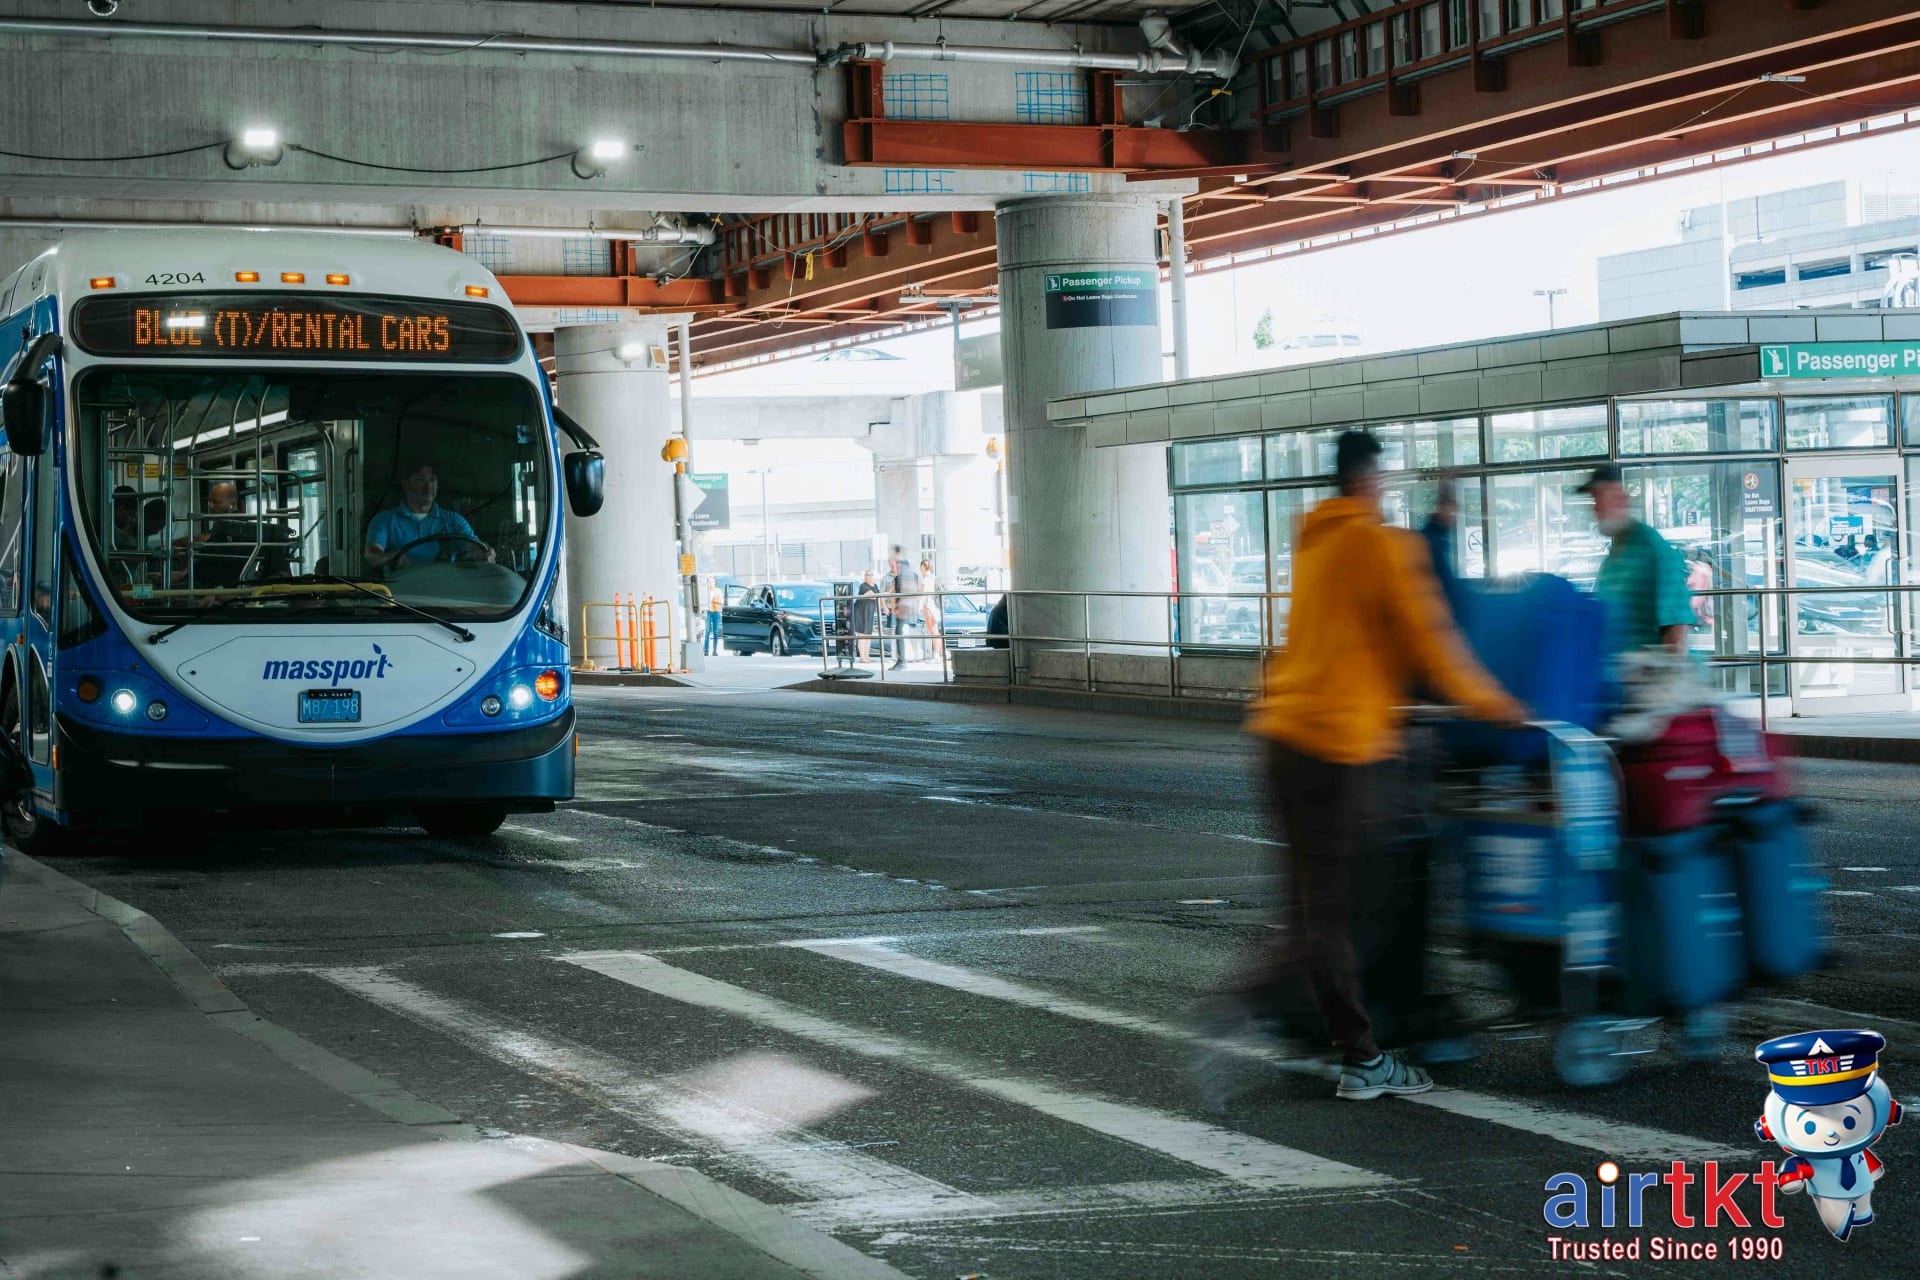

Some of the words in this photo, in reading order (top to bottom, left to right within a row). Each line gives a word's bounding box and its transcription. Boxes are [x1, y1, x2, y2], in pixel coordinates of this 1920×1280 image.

[145, 271, 206, 285] 4204
[1062, 277, 1112, 287] Passenger
[1114, 275, 1141, 286] Pickup
[135, 309, 202, 345] BLUE
[214, 311, 370, 349] (T)/RENTAL
[382, 315, 449, 350] CARS
[1797, 352, 1898, 373] Passenger
[263, 648, 391, 687] massport
